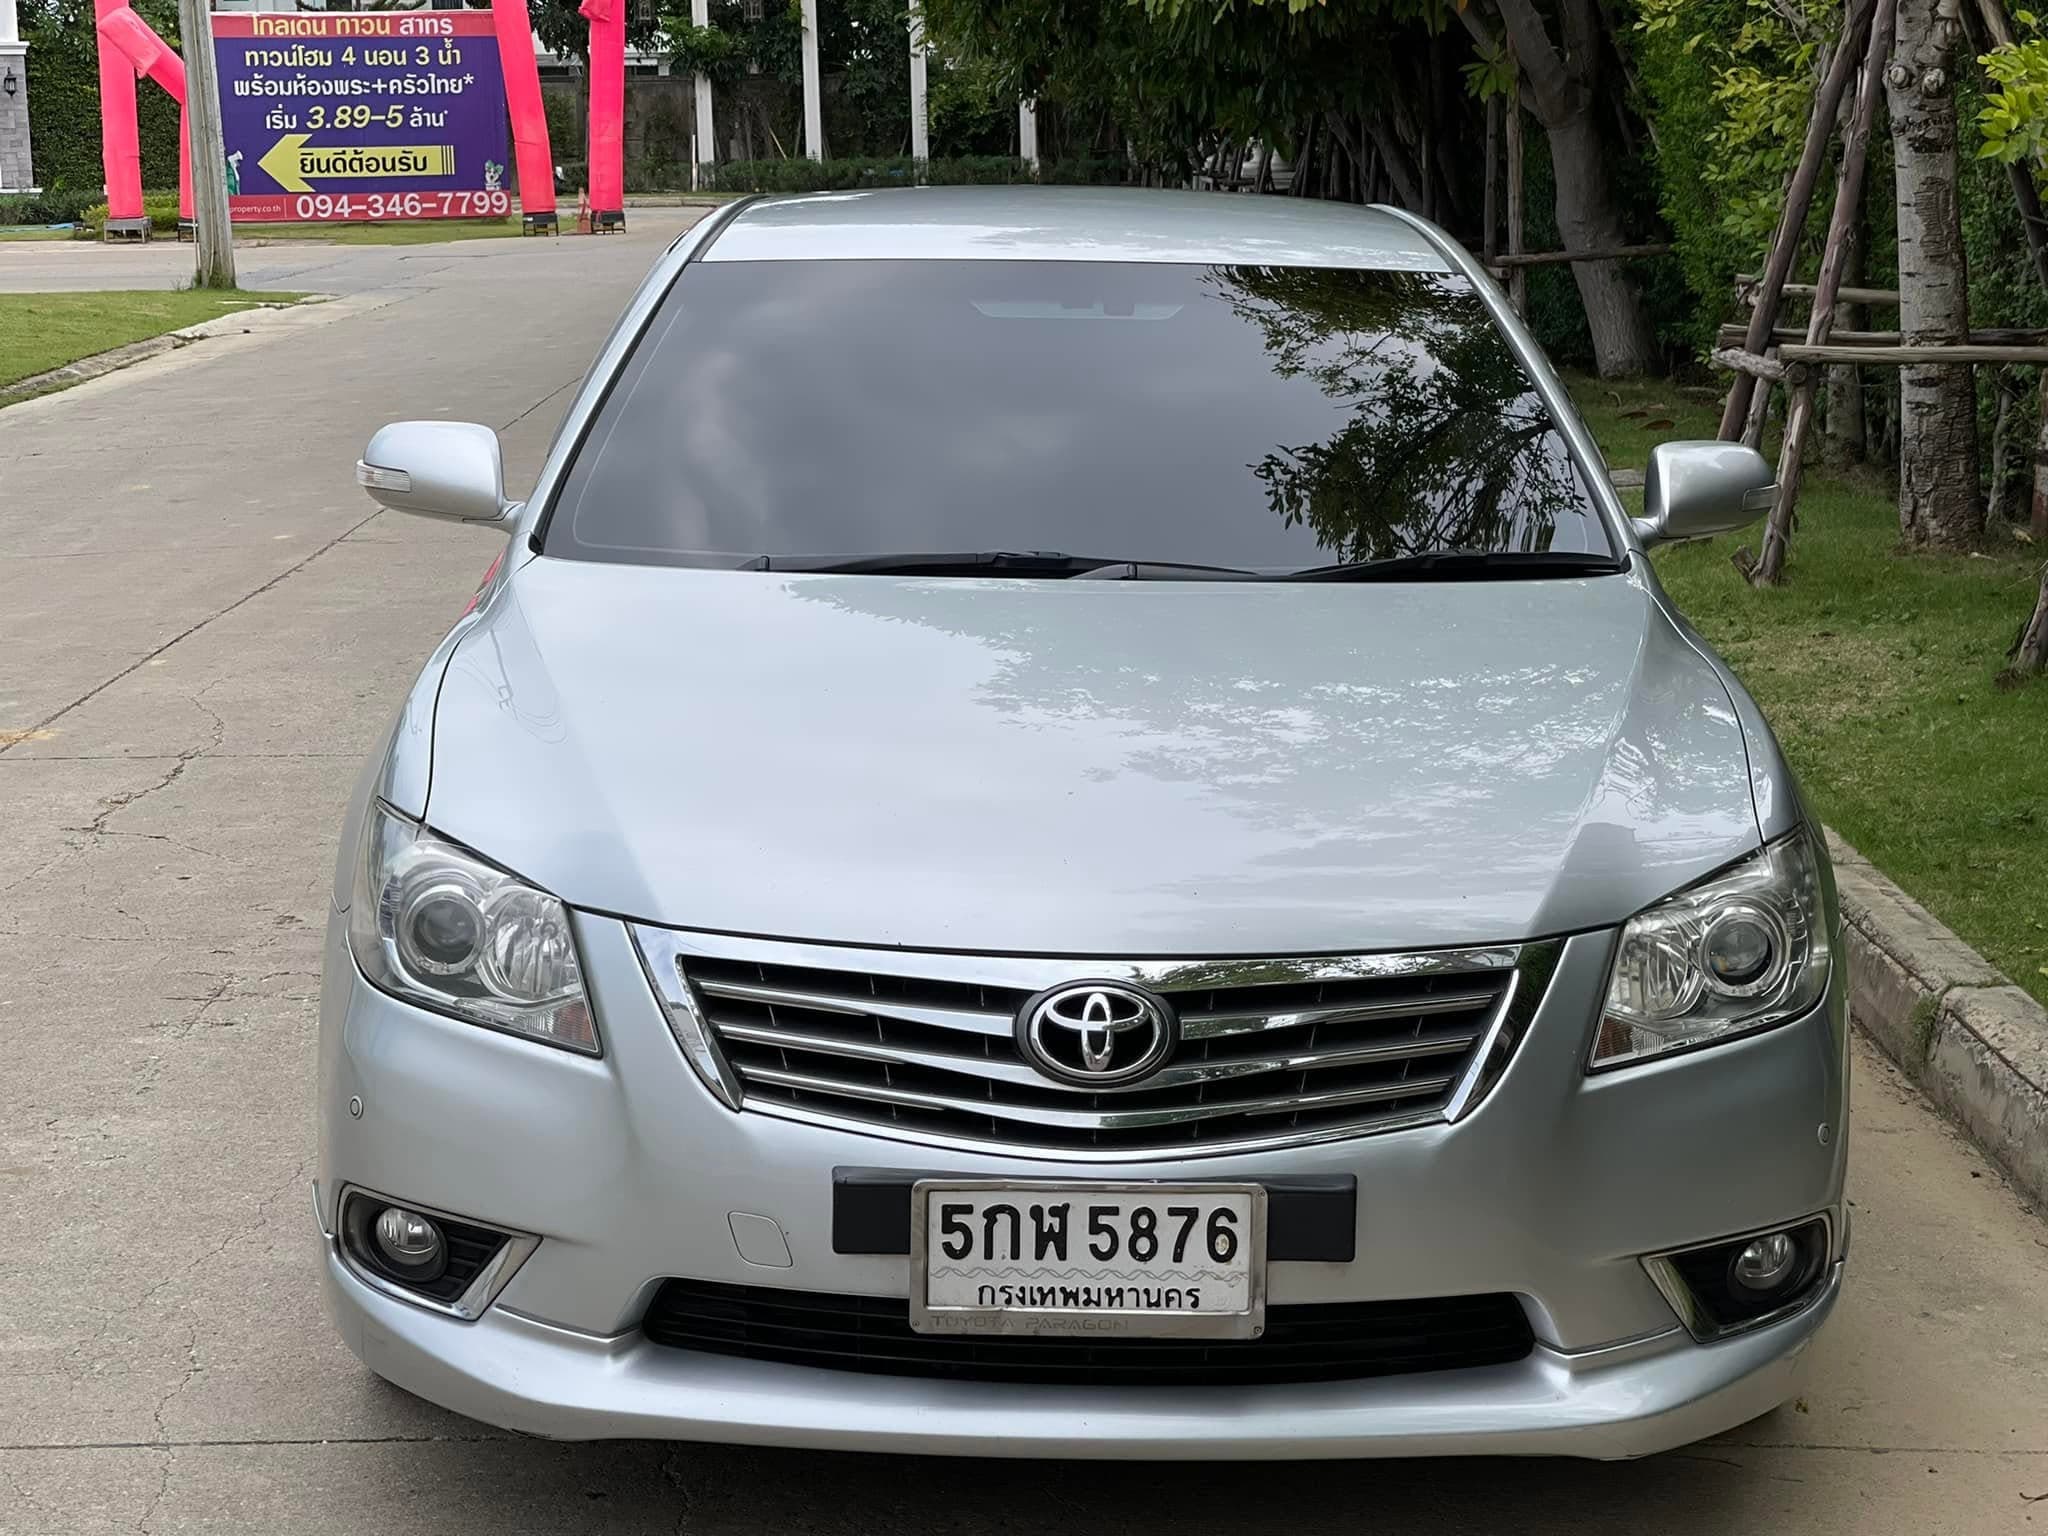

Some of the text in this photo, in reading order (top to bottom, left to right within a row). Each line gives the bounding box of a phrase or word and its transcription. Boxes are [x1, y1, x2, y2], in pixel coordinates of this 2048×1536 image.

[399, 16, 454, 36] สาทร
[245, 38, 461, 67] ทาวน์โฮม 4 นอน 3 น้ำ
[265, 104, 297, 129] เริ่ม
[306, 104, 404, 129] 3.89-5
[300, 150, 428, 174] ยินดีต้อนรับ
[296, 191, 508, 219] 094-346-7799
[941, 1203, 1239, 1264] 5กฬ 5876
[930, 1314, 1129, 1332] TOYOTA PARAGON
